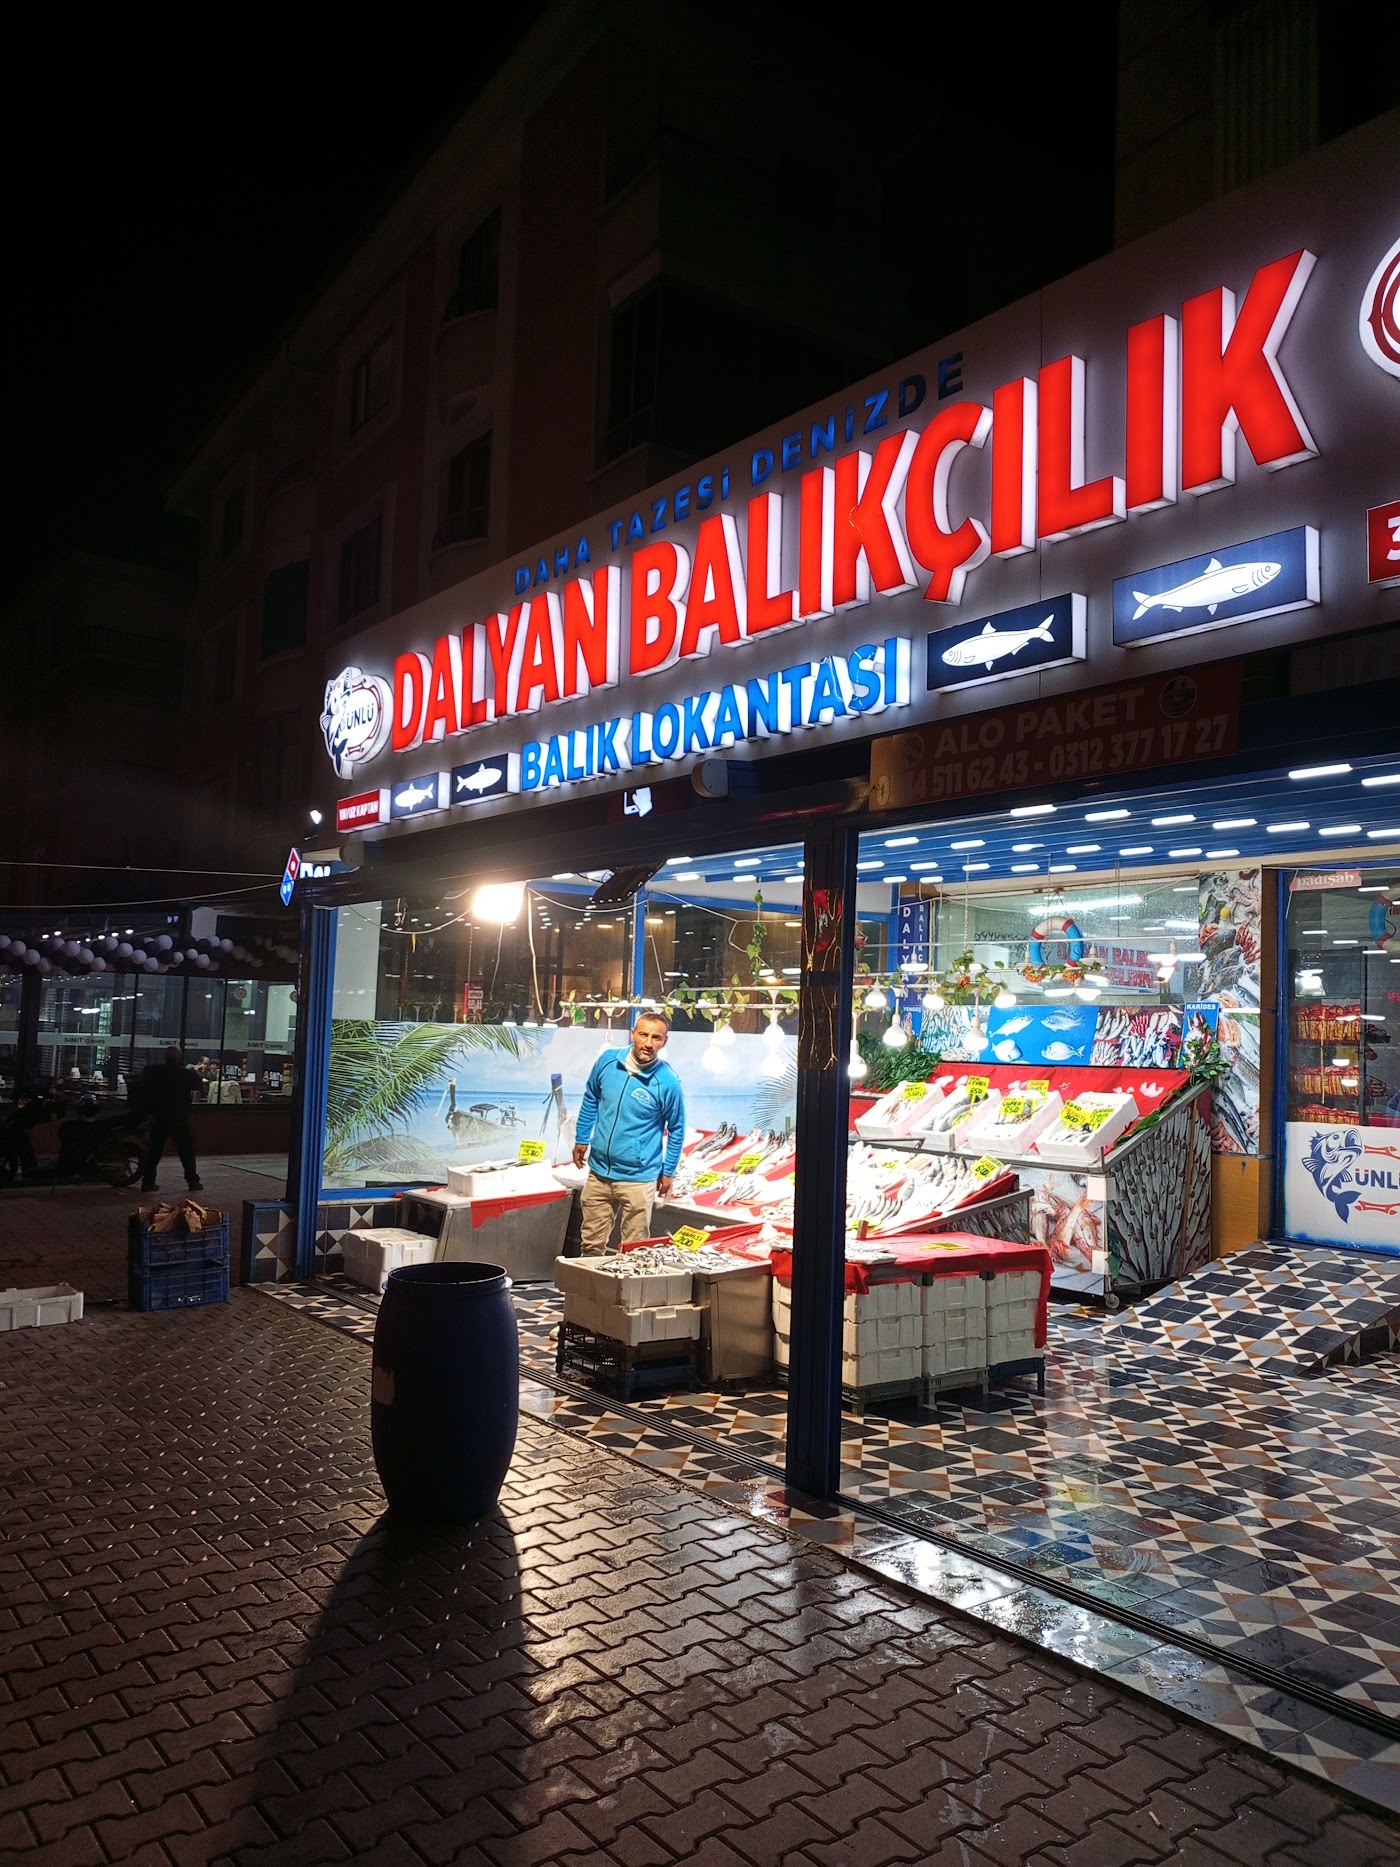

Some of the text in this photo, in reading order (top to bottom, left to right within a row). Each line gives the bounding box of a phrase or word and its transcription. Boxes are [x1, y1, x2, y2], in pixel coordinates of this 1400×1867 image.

[393, 248, 1320, 752] DALYAN BALIKÇILIK
[514, 536, 591, 595] DAHA
[347, 703, 375, 729] ÜNLÜ
[521, 637, 911, 792] BALIK LOKANTASI
[935, 687, 1146, 758] ALO PAKET
[932, 768, 961, 796] 511
[967, 759, 995, 792] 62
[998, 750, 1029, 784] 43
[1049, 738, 1105, 777] 0312
[1110, 727, 1156, 767] 377
[1160, 721, 1191, 758] 17
[1195, 714, 1230, 754] 27
[1355, 1168, 1400, 1190] ÜNL
